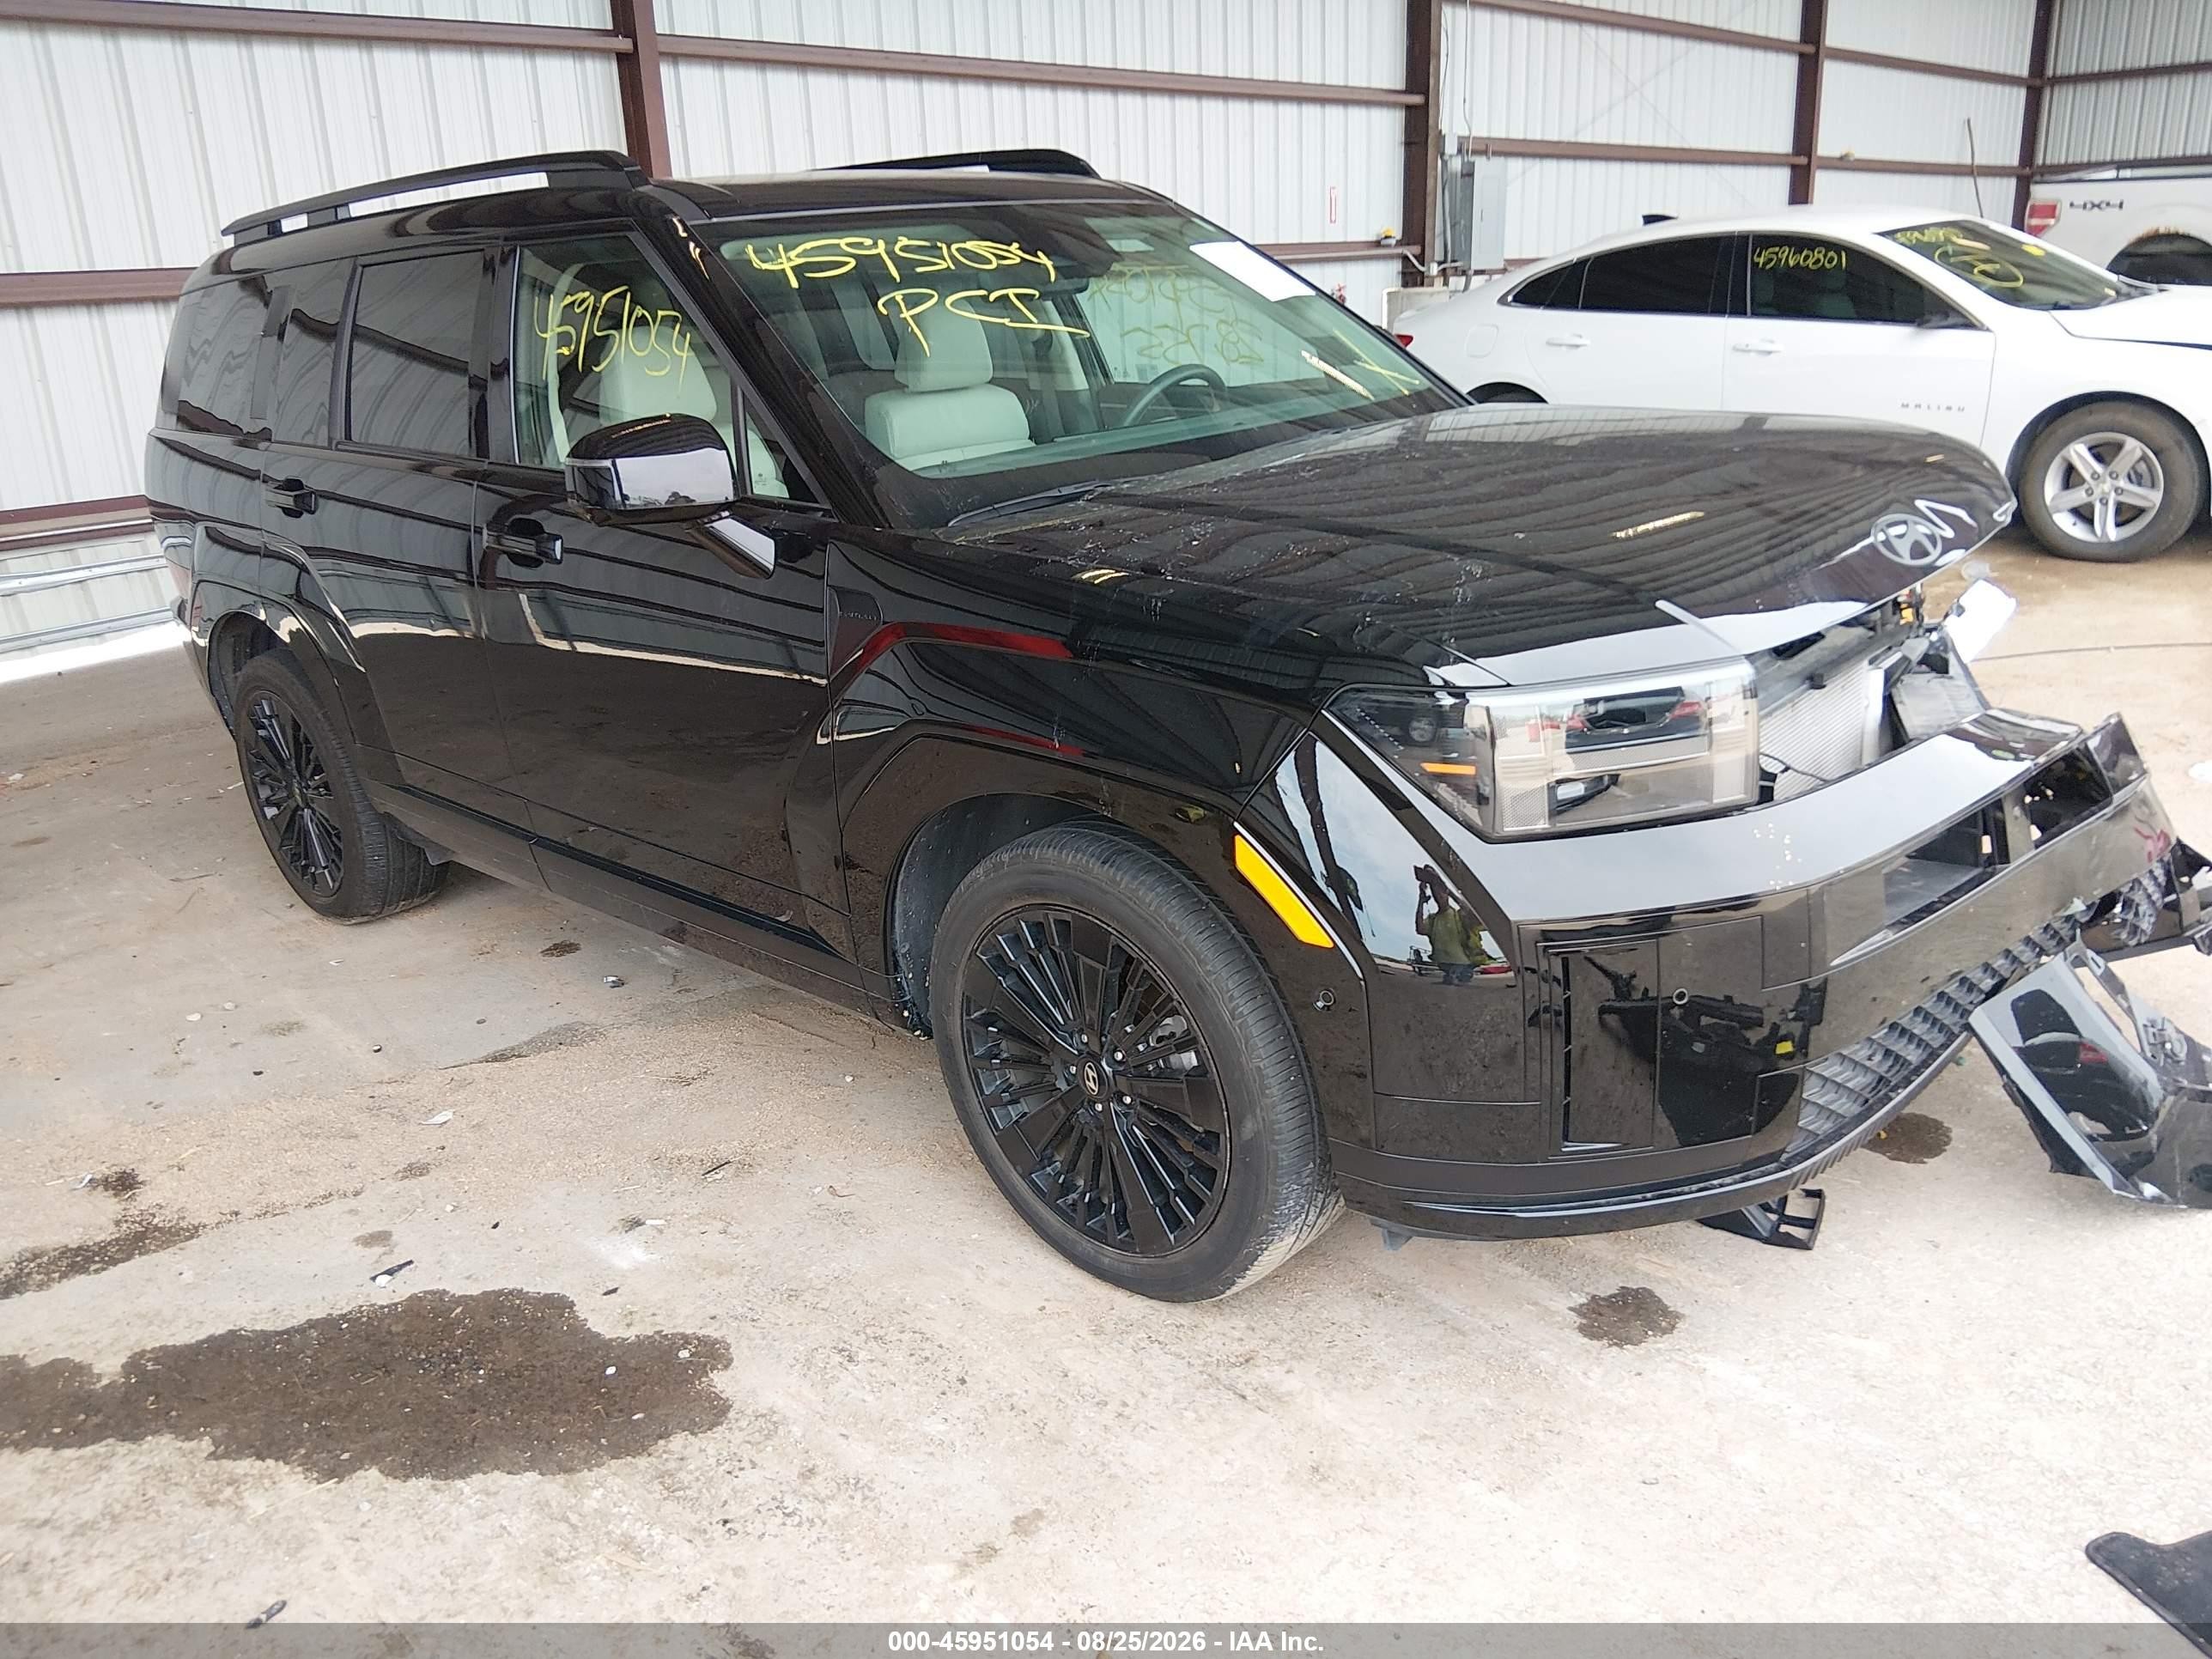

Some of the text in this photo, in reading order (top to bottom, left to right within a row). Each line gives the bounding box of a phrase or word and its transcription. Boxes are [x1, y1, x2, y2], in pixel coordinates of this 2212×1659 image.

[744, 236, 1057, 289] 45951054
[1753, 246, 1846, 270] 45960801
[532, 285, 694, 398] 45951054
